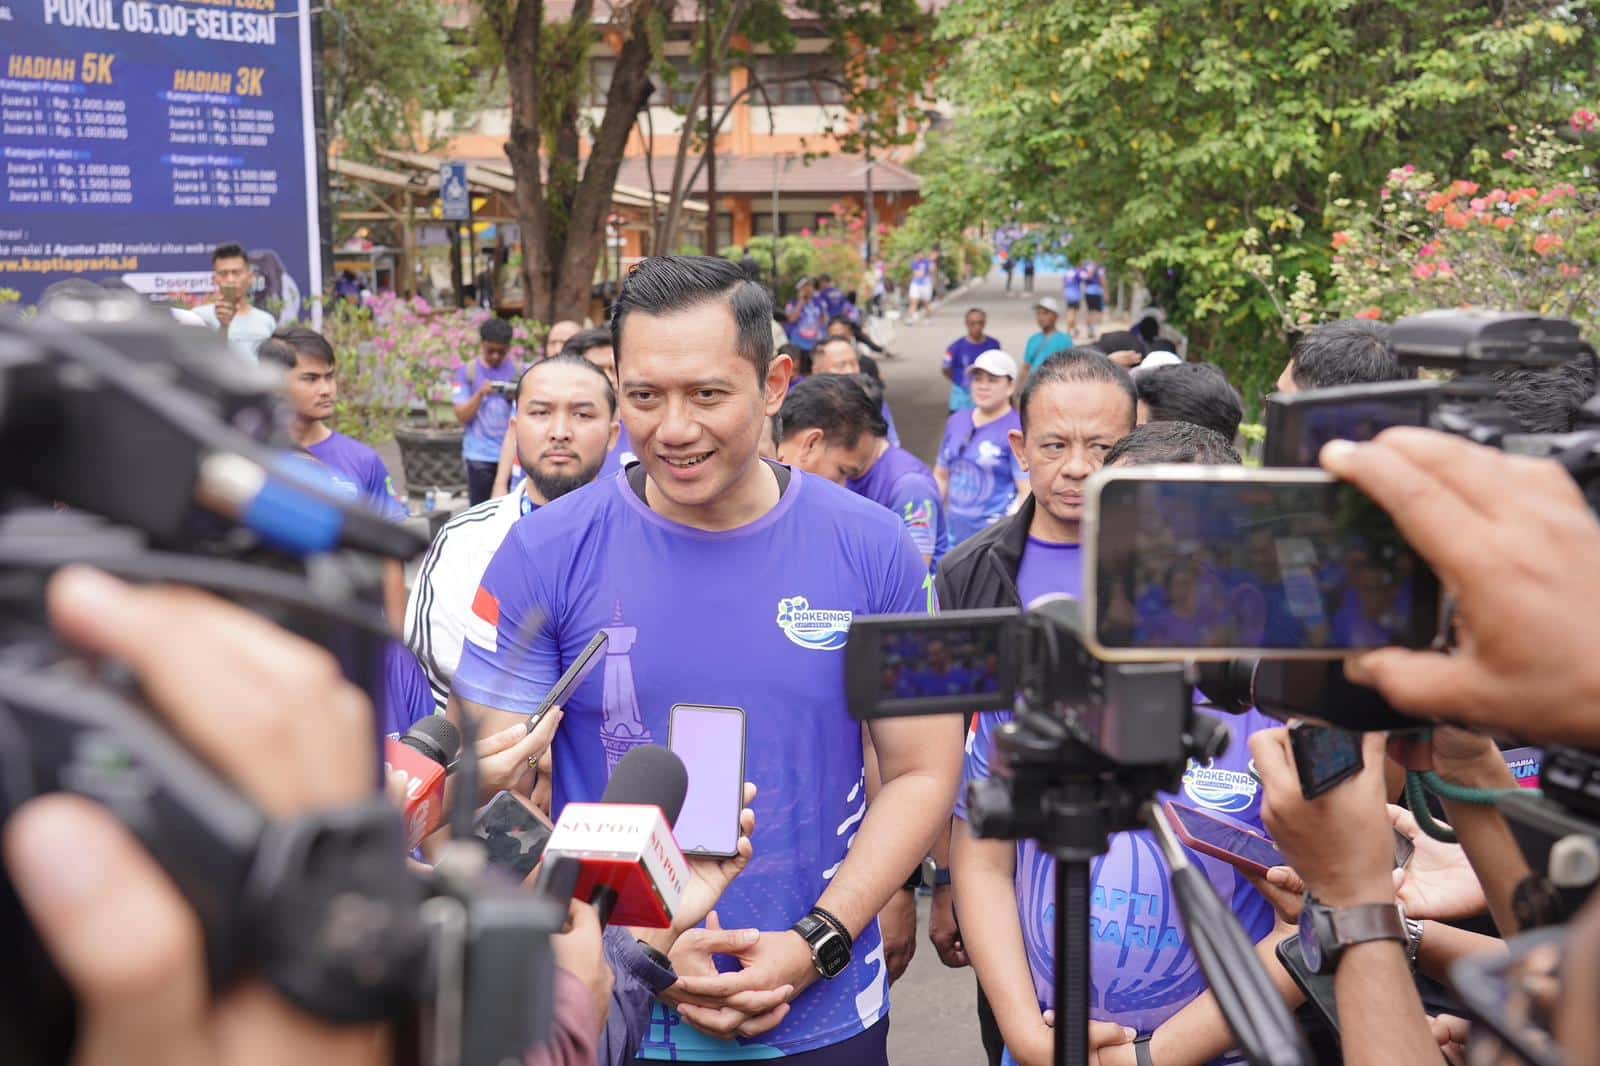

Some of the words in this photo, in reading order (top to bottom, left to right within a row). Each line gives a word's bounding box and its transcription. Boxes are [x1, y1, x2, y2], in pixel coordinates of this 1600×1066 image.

[43, 0, 120, 31] PUKUL
[121, 0, 276, 45] 05.00-SELESAI
[8, 54, 76, 81] HADIAH
[81, 52, 115, 84] 5K
[174, 69, 232, 94] HADIAH
[236, 66, 264, 97] 3K
[53, 243, 96, 257] Agustus
[97, 242, 123, 256] 2024
[793, 611, 851, 622] RAKERNAS
[1196, 769, 1257, 786] RAKERNAS
[1089, 885, 1160, 918] APTI
